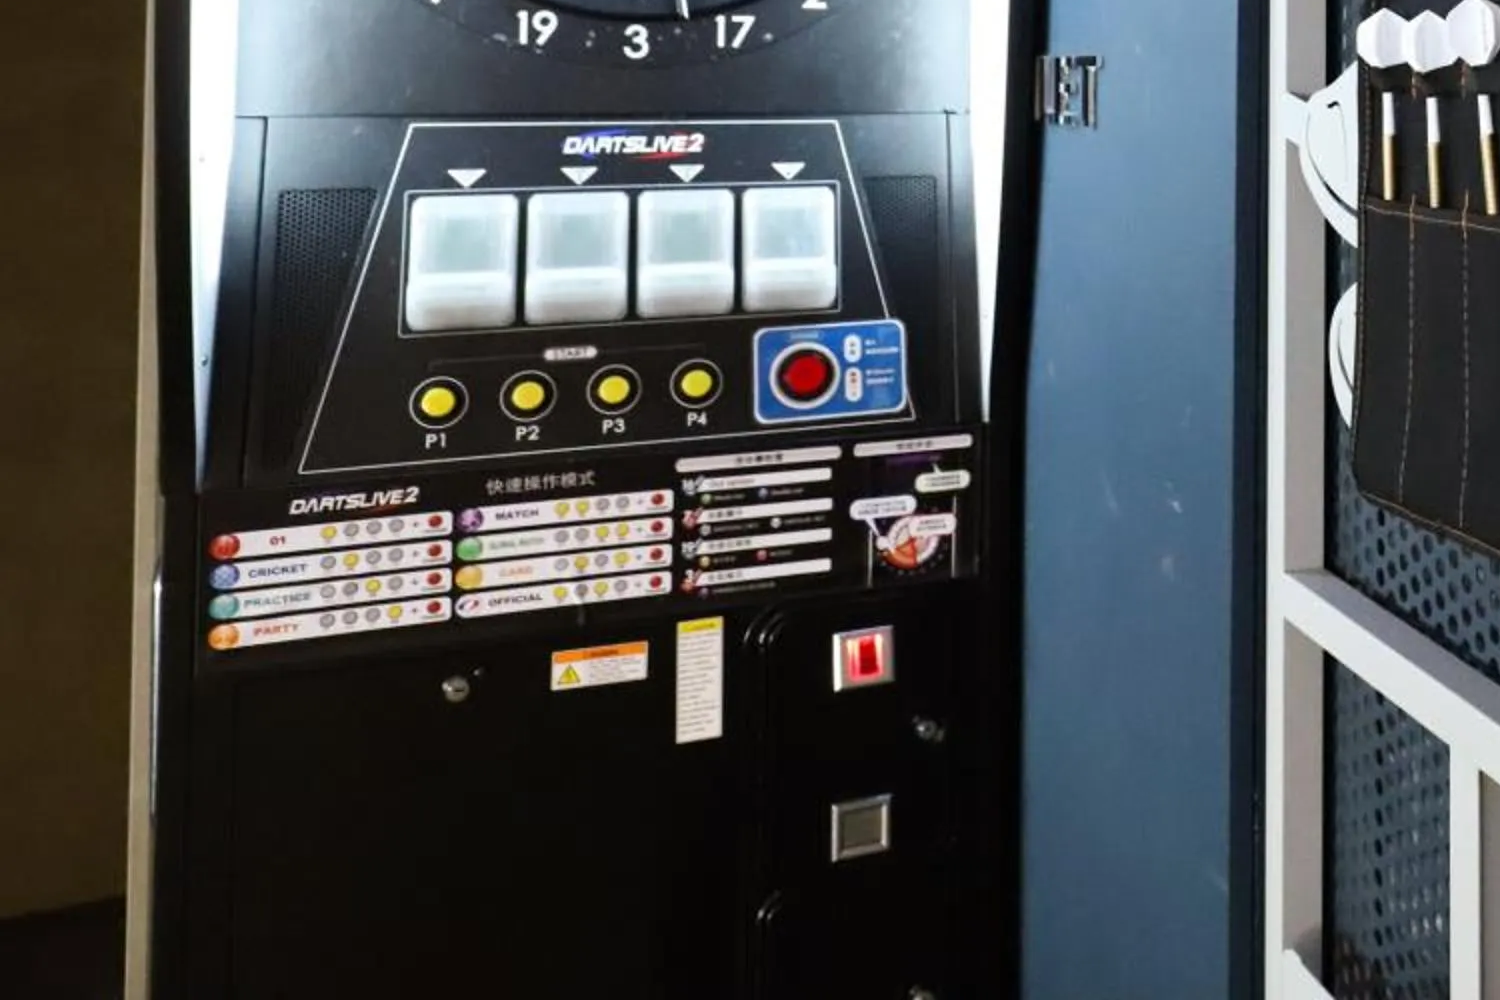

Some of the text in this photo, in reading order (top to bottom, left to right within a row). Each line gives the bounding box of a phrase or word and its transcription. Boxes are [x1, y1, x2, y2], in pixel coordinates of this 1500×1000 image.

[516, 9, 559, 47] 19
[714, 15, 757, 50] 17
[623, 24, 651, 61] 3
[562, 133, 706, 155] DARTSLIVE2
[602, 418, 626, 434] P3
[687, 412, 708, 427] P4
[425, 433, 447, 448] P1
[515, 425, 540, 441] P2
[486, 470, 597, 496] 快速操作模式
[288, 486, 420, 515] DARTSLIVE2
[495, 508, 539, 521] MATCH
[269, 535, 286, 546] 01
[248, 563, 308, 579] CRICKET
[243, 592, 311, 607] PRACTICE
[488, 592, 544, 608] OFFICIAL
[253, 623, 300, 637] PARTY
